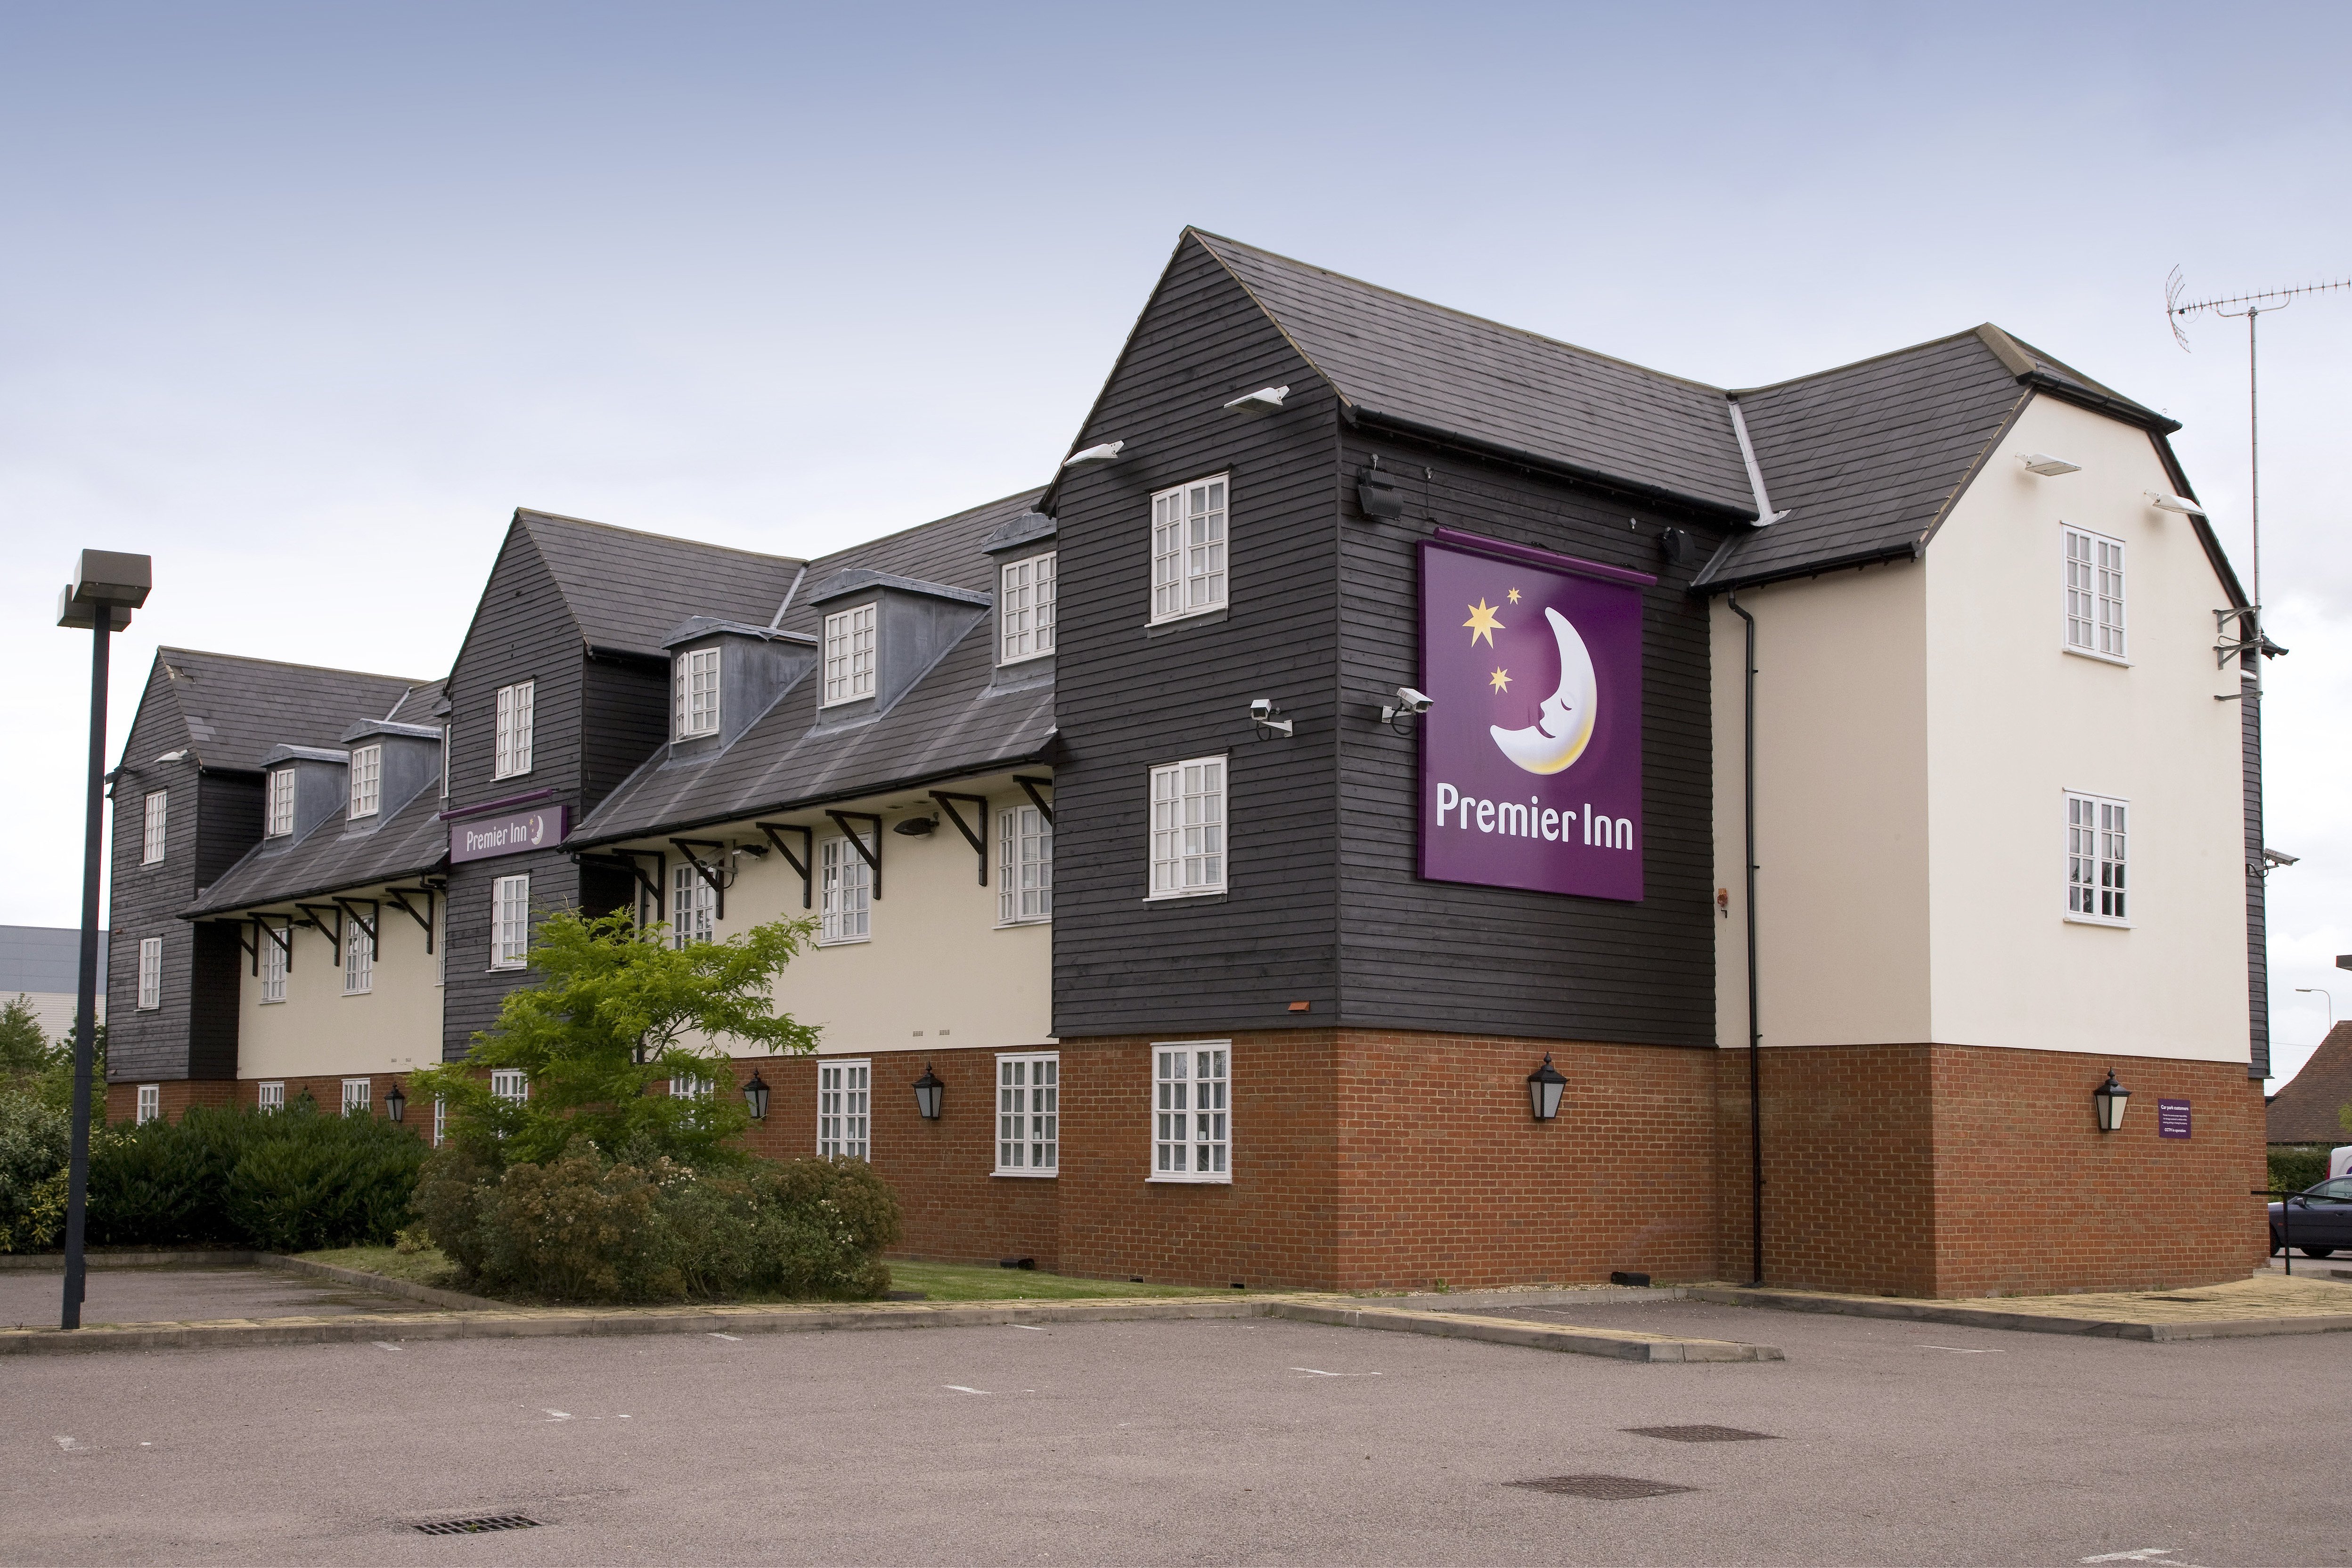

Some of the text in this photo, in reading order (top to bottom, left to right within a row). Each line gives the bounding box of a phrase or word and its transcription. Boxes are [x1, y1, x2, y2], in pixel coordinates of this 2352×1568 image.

[466, 822, 527, 851] Premier Inn
[1437, 783, 1633, 850] Premier Inn
